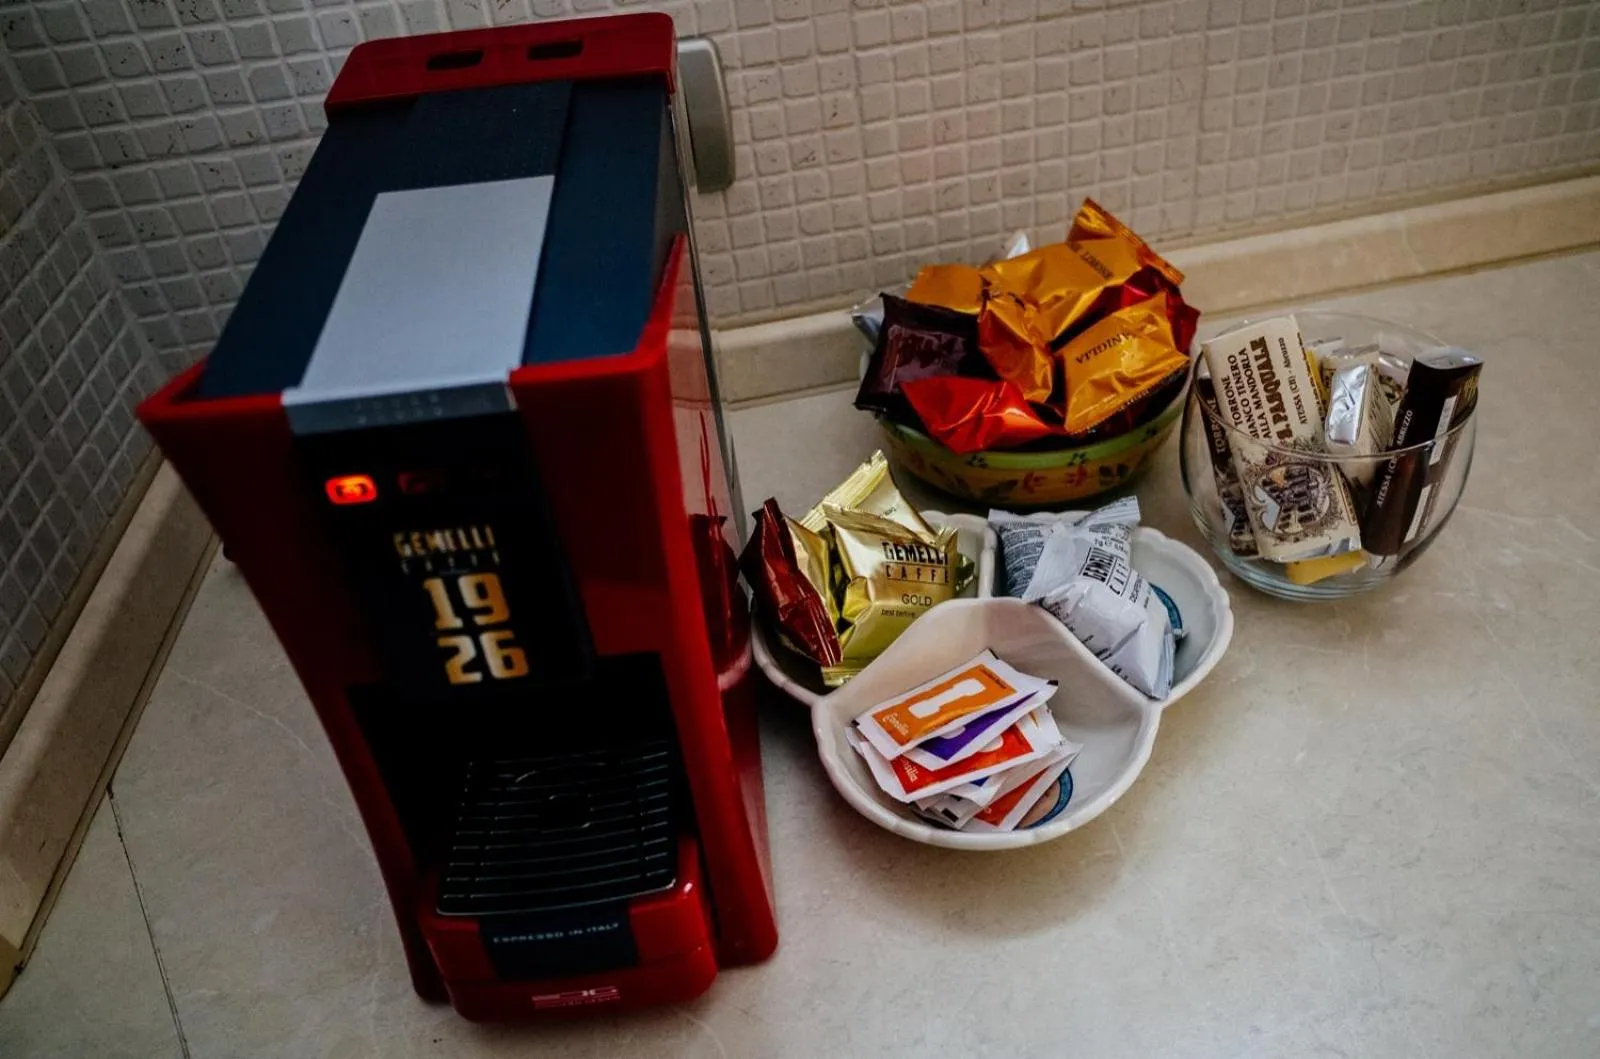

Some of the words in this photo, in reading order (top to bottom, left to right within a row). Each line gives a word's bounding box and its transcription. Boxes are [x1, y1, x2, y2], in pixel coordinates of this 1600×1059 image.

[1228, 355, 1247, 396] TENERO
[1239, 348, 1262, 410] MANDORLA
[1250, 336, 1289, 425] PASQUALE
[1222, 376, 1243, 426] TORRONE
[1293, 394, 1308, 424] ATESSA
[1258, 411, 1272, 439] ALLA
[881, 541, 949, 565] GEMELLI
[423, 573, 510, 630] 19
[902, 593, 932, 606] GOLD
[437, 629, 529, 684] 26
